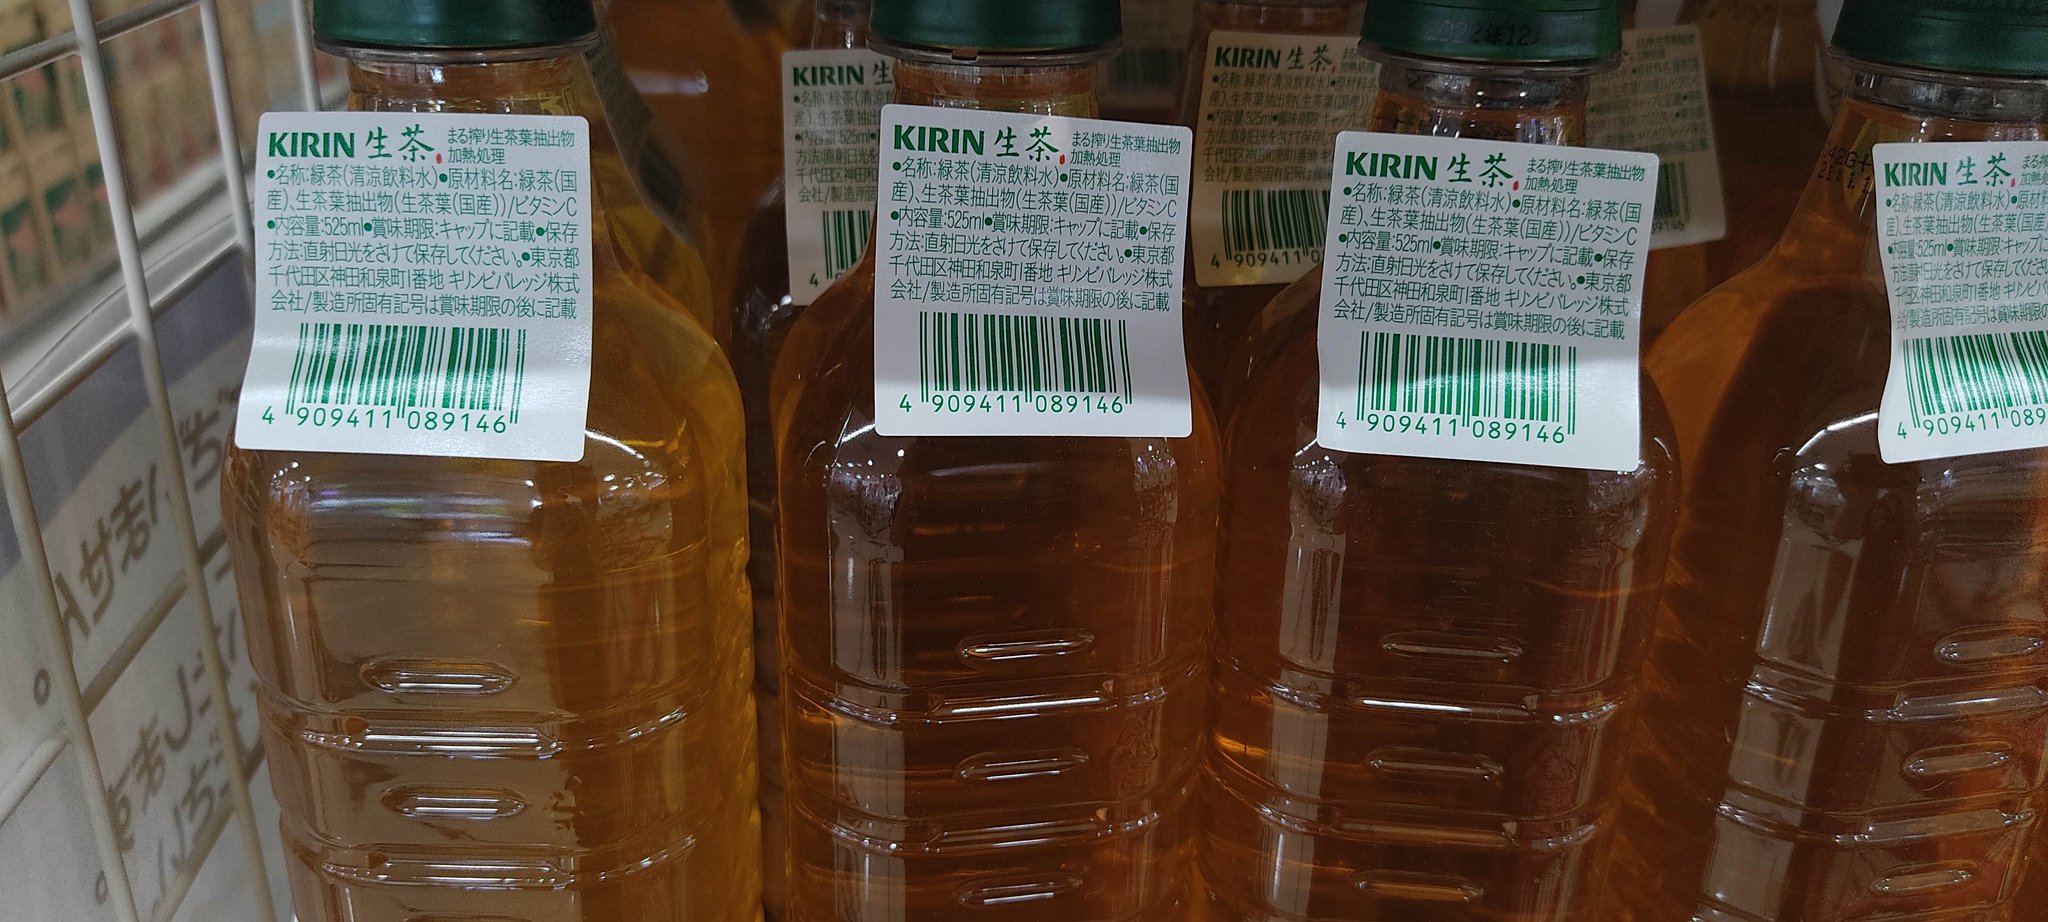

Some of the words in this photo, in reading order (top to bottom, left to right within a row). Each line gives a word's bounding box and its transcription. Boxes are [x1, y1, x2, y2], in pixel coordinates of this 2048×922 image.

[1214, 46, 1281, 69] KIRIN
[1287, 44, 1333, 73] 生茶
[793, 65, 865, 87] KIRIN
[268, 132, 355, 158] KIRIN
[365, 124, 435, 163] 生茶
[447, 147, 506, 165] 加熱処理
[893, 124, 985, 155] KIRIN
[993, 126, 1060, 162] 生茶
[1070, 150, 1121, 167] 加熱処理
[1345, 151, 1438, 181] KIRIN
[1446, 153, 1513, 188] 生茶
[1884, 162, 1948, 188] KIRIN
[1955, 152, 2012, 188] 生茶
[1523, 176, 1578, 194] 加熱処理
[1211, 254, 1220, 269] 4
[1234, 249, 1302, 268] 909411
[449, 269, 581, 295] キリンビバレッジ株式
[809, 273, 819, 288] 4
[1056, 265, 1174, 290] キリンビバレッジ株式
[1504, 287, 1629, 317] キリンビバレッジ株式
[899, 394, 912, 412] 4
[932, 394, 1021, 413] 909411
[1035, 394, 1124, 414] 089146
[262, 406, 275, 425] 4
[296, 407, 393, 429] 909411
[407, 410, 507, 434] 089146
[1336, 411, 1347, 430] 4
[1367, 413, 1457, 437] 909411
[1472, 420, 1565, 444] 089146
[1897, 421, 1907, 440] 4
[1922, 412, 2000, 437] 909411
[2010, 407, 2047, 428] 089
